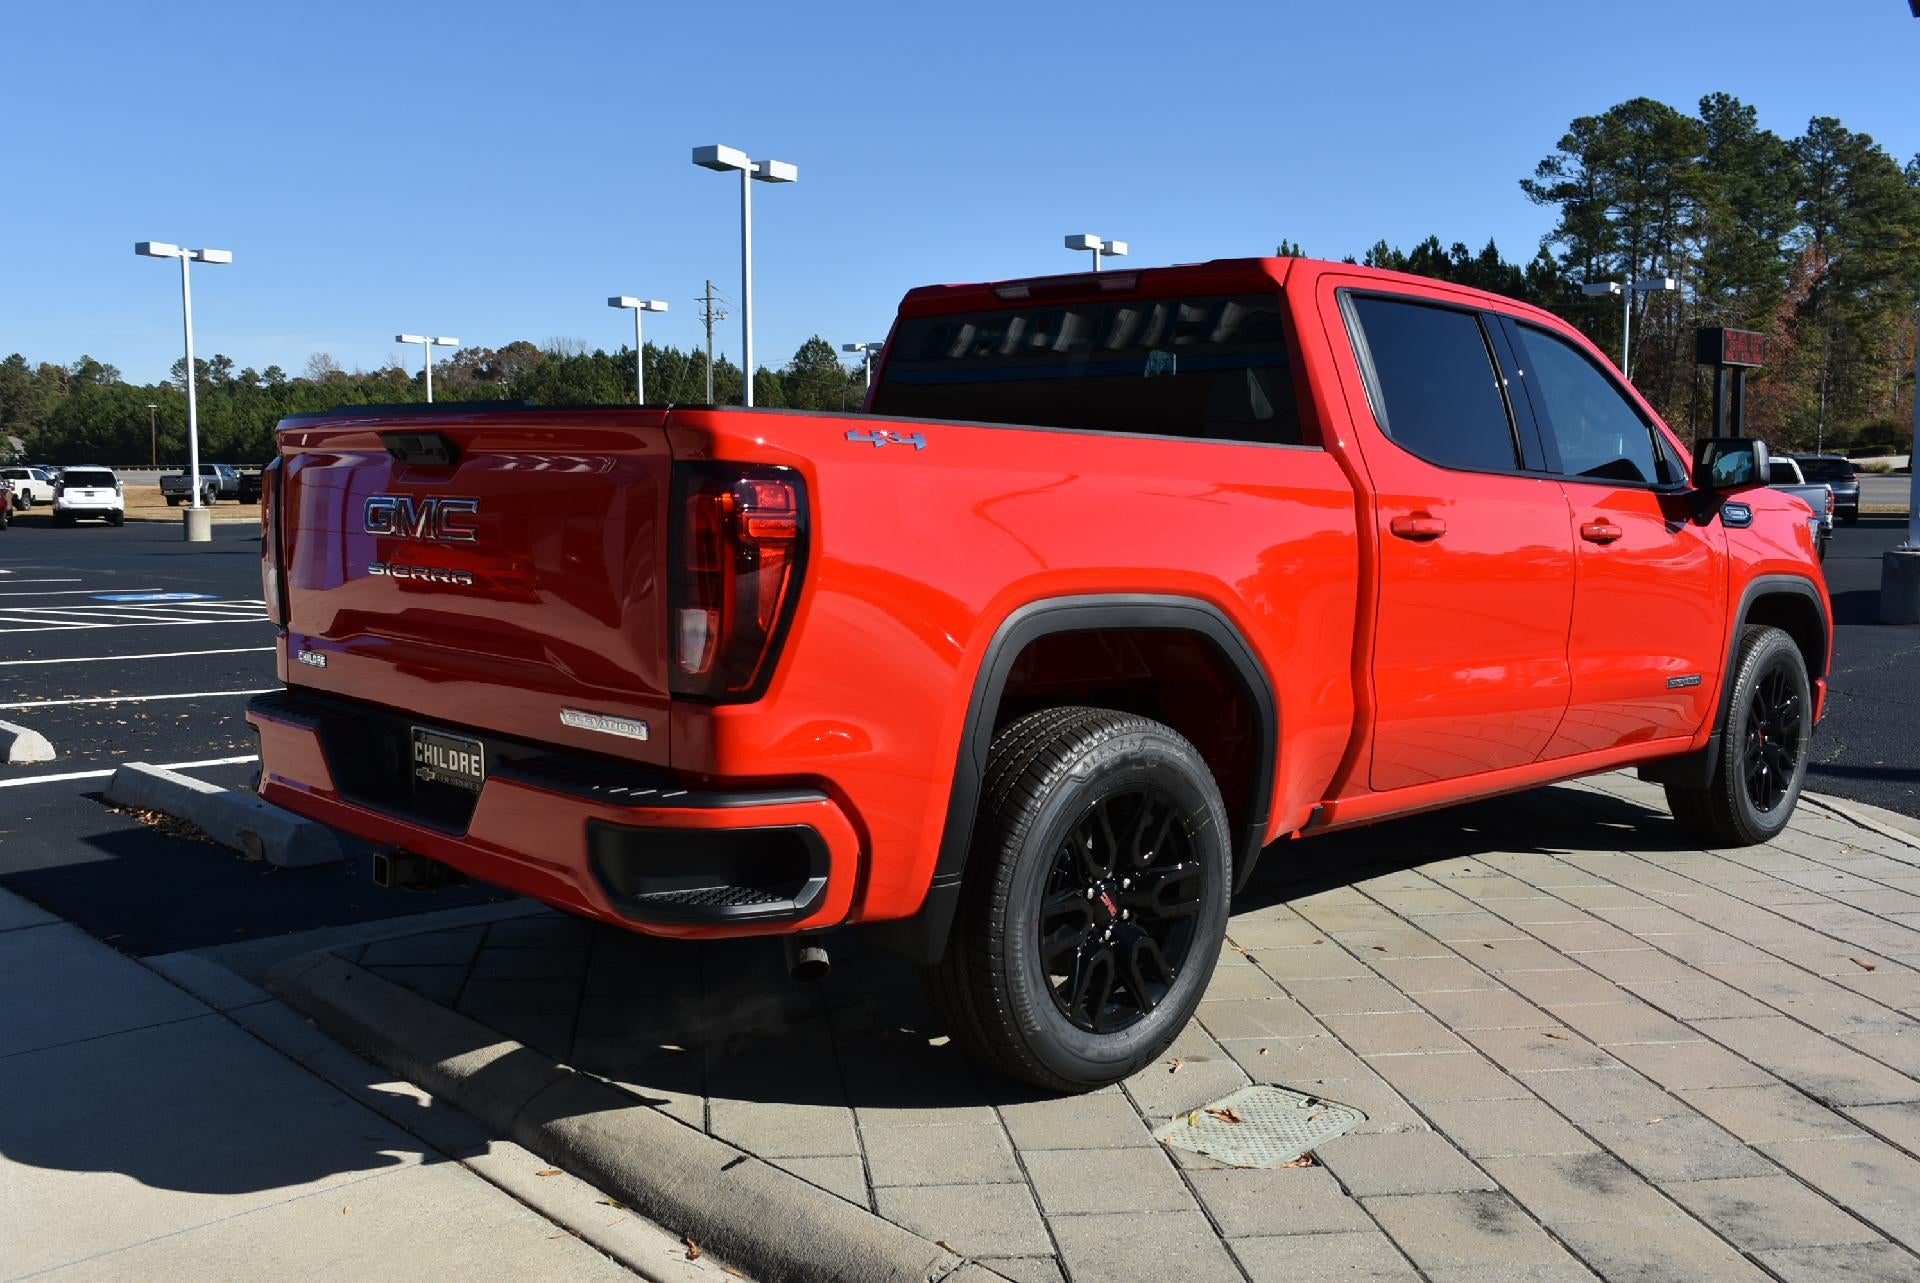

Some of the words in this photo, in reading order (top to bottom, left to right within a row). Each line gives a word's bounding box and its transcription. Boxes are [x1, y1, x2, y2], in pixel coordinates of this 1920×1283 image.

[364, 496, 478, 541] GMC
[368, 561, 473, 585] SIERRA
[299, 651, 326, 667] CHILDRE
[565, 712, 643, 736] ELEVATION
[414, 741, 481, 777] CHILDRE
